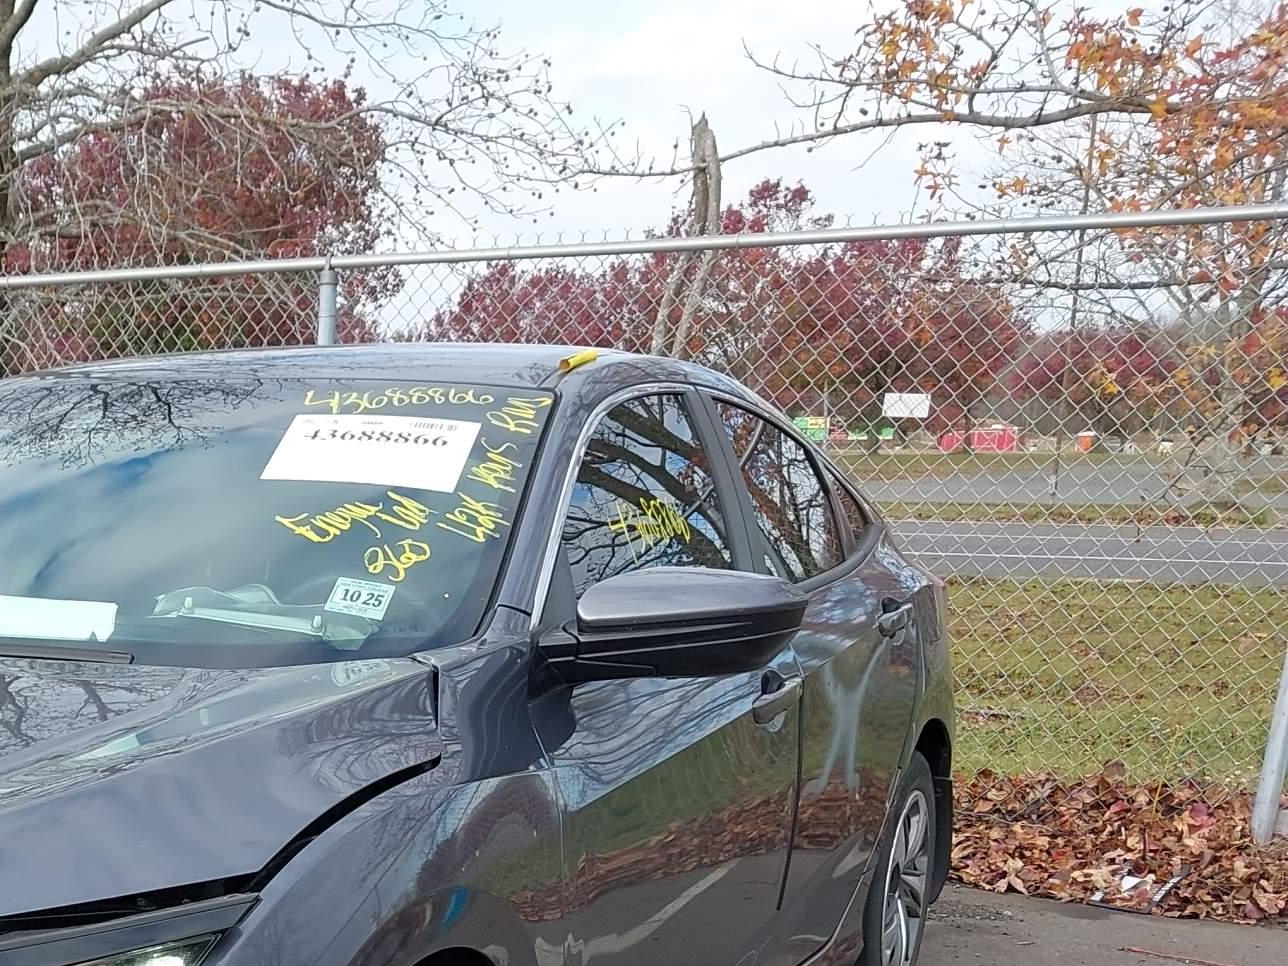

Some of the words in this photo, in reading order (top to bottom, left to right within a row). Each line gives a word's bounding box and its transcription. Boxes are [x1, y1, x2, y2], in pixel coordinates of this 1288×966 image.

[304, 387, 495, 414] 43688866
[304, 429, 448, 447] 43688866
[340, 588, 362, 603] 10
[361, 592, 386, 608] 25
